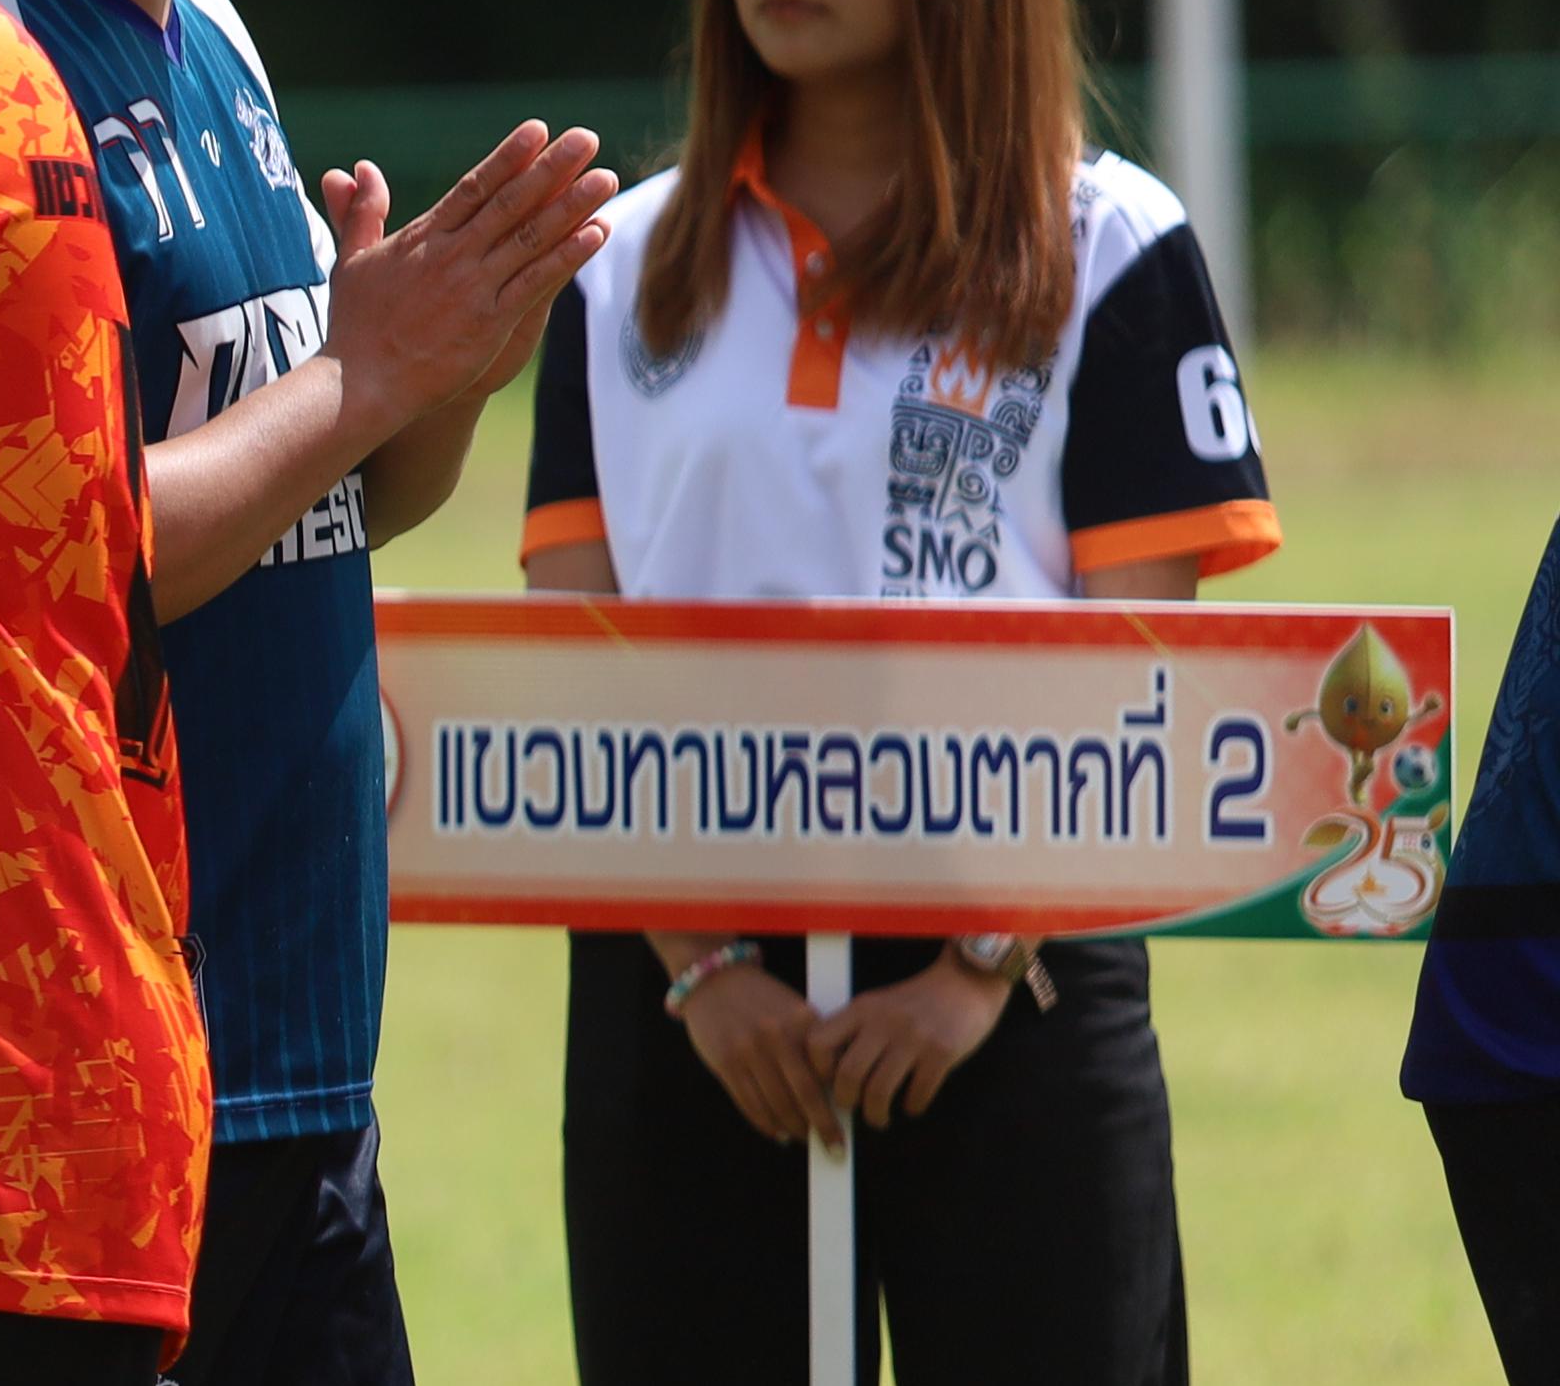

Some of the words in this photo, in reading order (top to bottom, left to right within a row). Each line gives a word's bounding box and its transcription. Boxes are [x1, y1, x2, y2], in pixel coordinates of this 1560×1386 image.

[1176, 343, 1263, 463] 6
[882, 524, 998, 593] SMO
[437, 666, 1167, 837] แขวงทางหลวงตากที่
[1208, 718, 1267, 839] 2
